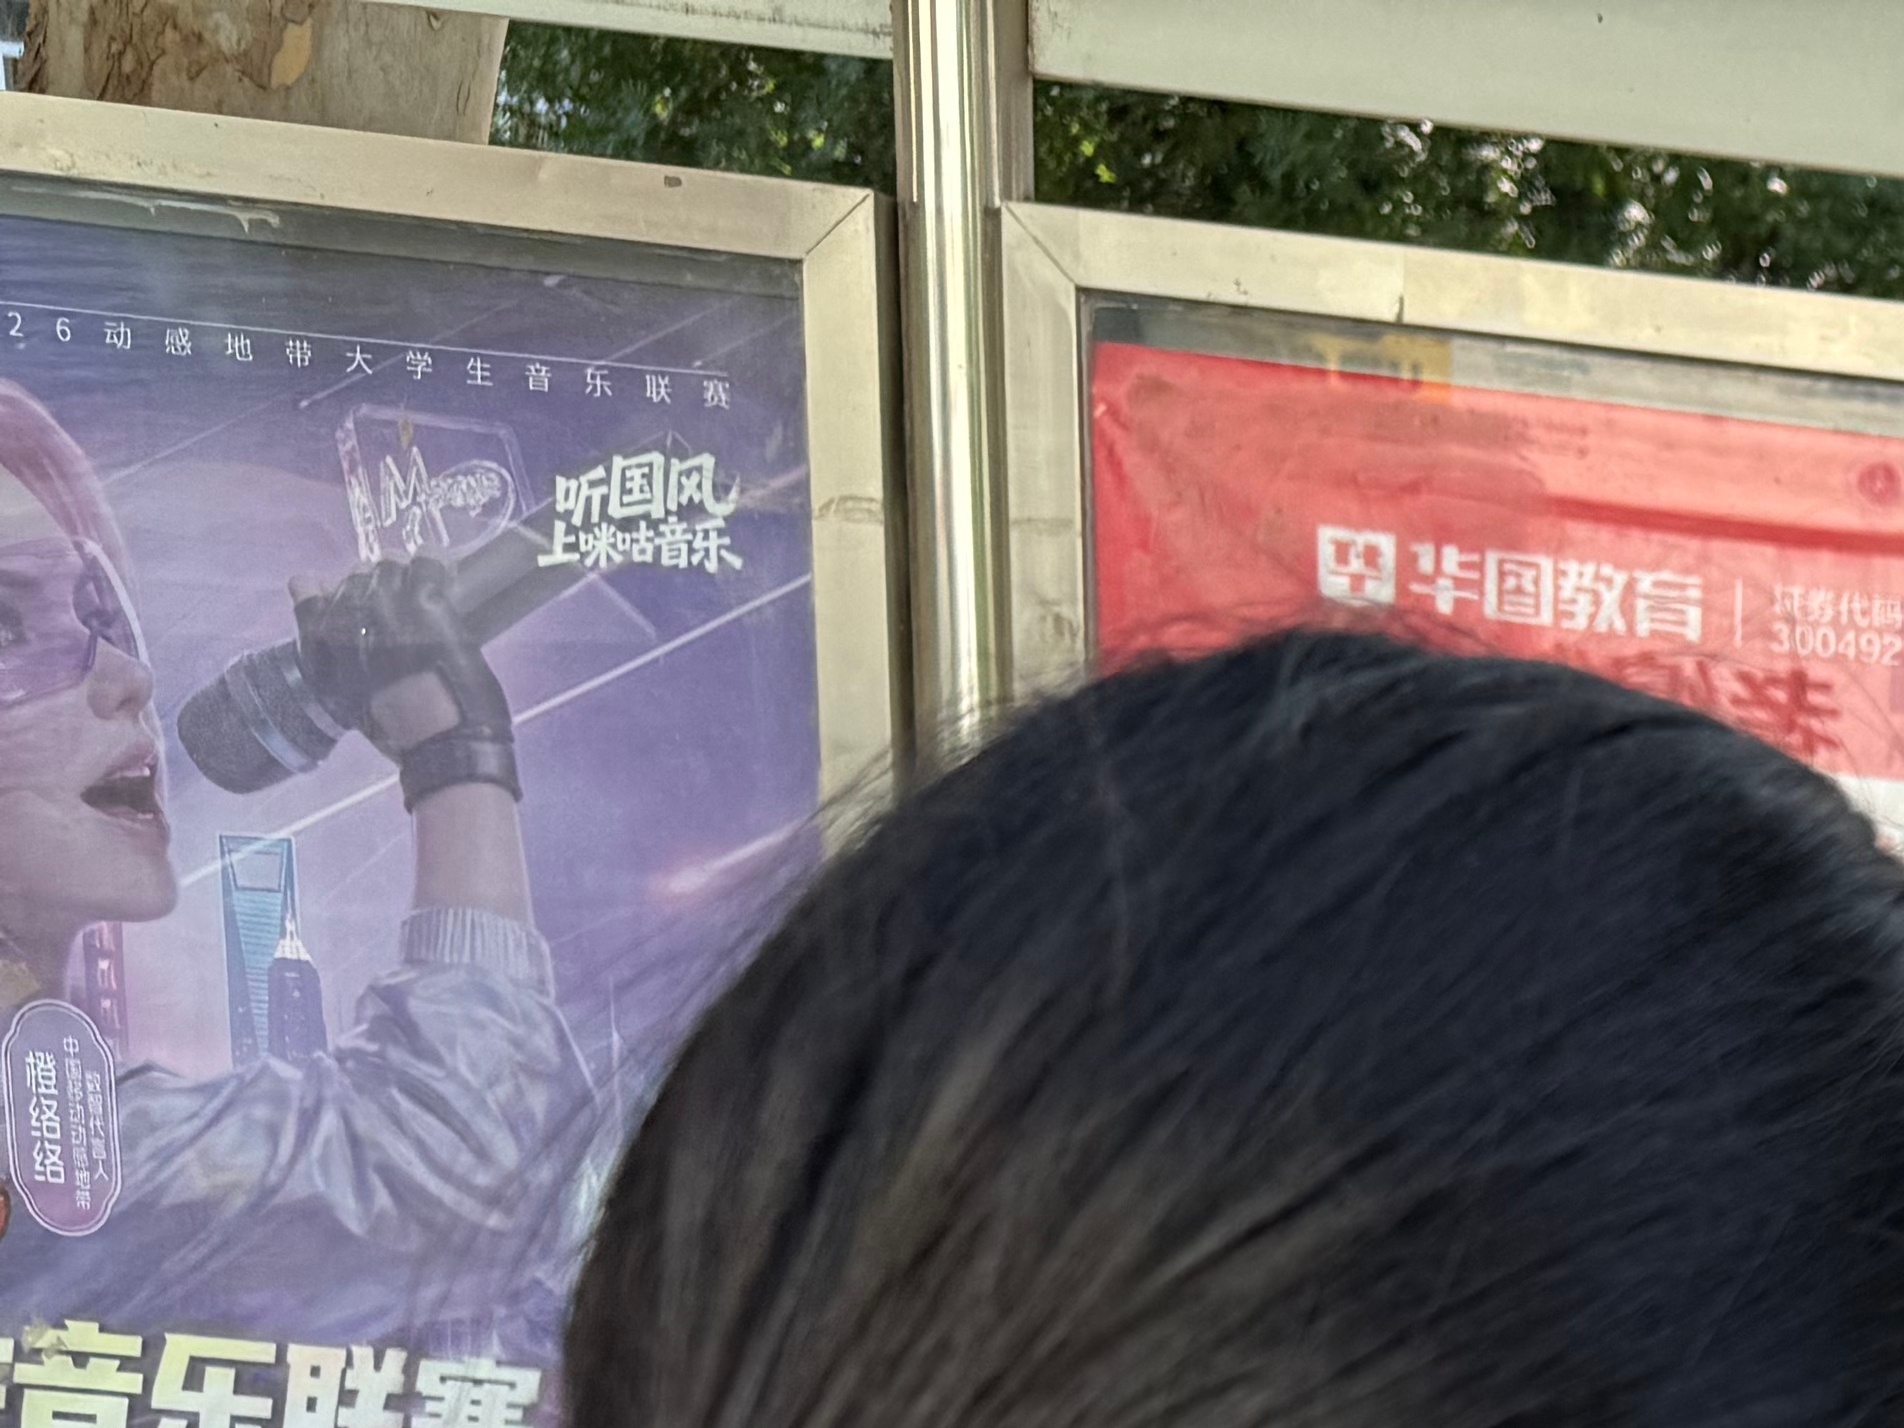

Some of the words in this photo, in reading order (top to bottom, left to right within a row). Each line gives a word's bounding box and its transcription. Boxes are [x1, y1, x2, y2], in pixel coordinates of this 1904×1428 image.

[8, 311, 731, 408] 26动感地带大学生音乐联赛
[555, 452, 738, 526] 听国风
[537, 516, 743, 574] 上咪咕音乐
[1409, 541, 1703, 644] 华图教育
[1770, 621, 1903, 666] 300492
[25, 1049, 65, 1185] 橙络络
